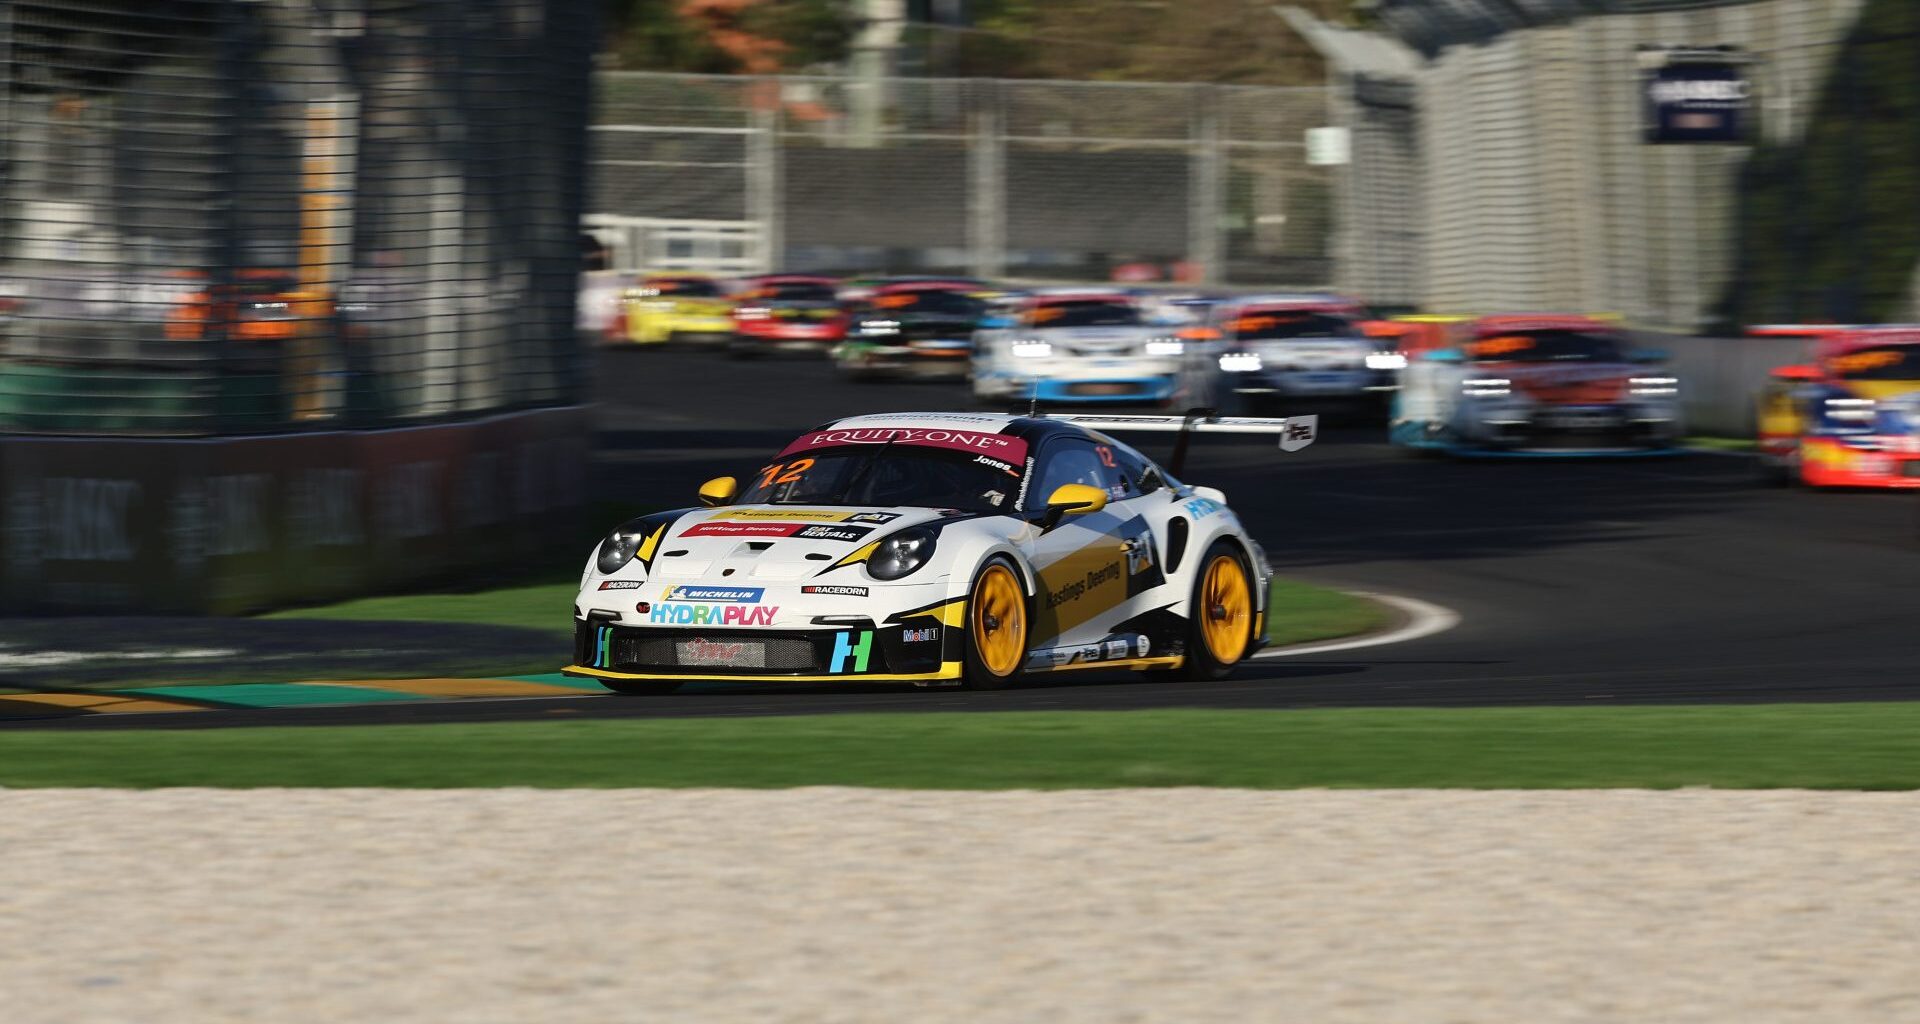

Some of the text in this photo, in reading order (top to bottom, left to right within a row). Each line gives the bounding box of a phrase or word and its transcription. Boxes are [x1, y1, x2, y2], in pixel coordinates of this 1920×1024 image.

[973, 455, 1012, 471] Jones
[759, 459, 814, 489] 12
[800, 531, 857, 539] RENTALS
[688, 589, 755, 599] MICHELIN
[814, 586, 867, 596] RACEBORN
[650, 603, 780, 626] HYDRAPLAY
[903, 629, 930, 643] Mobil
